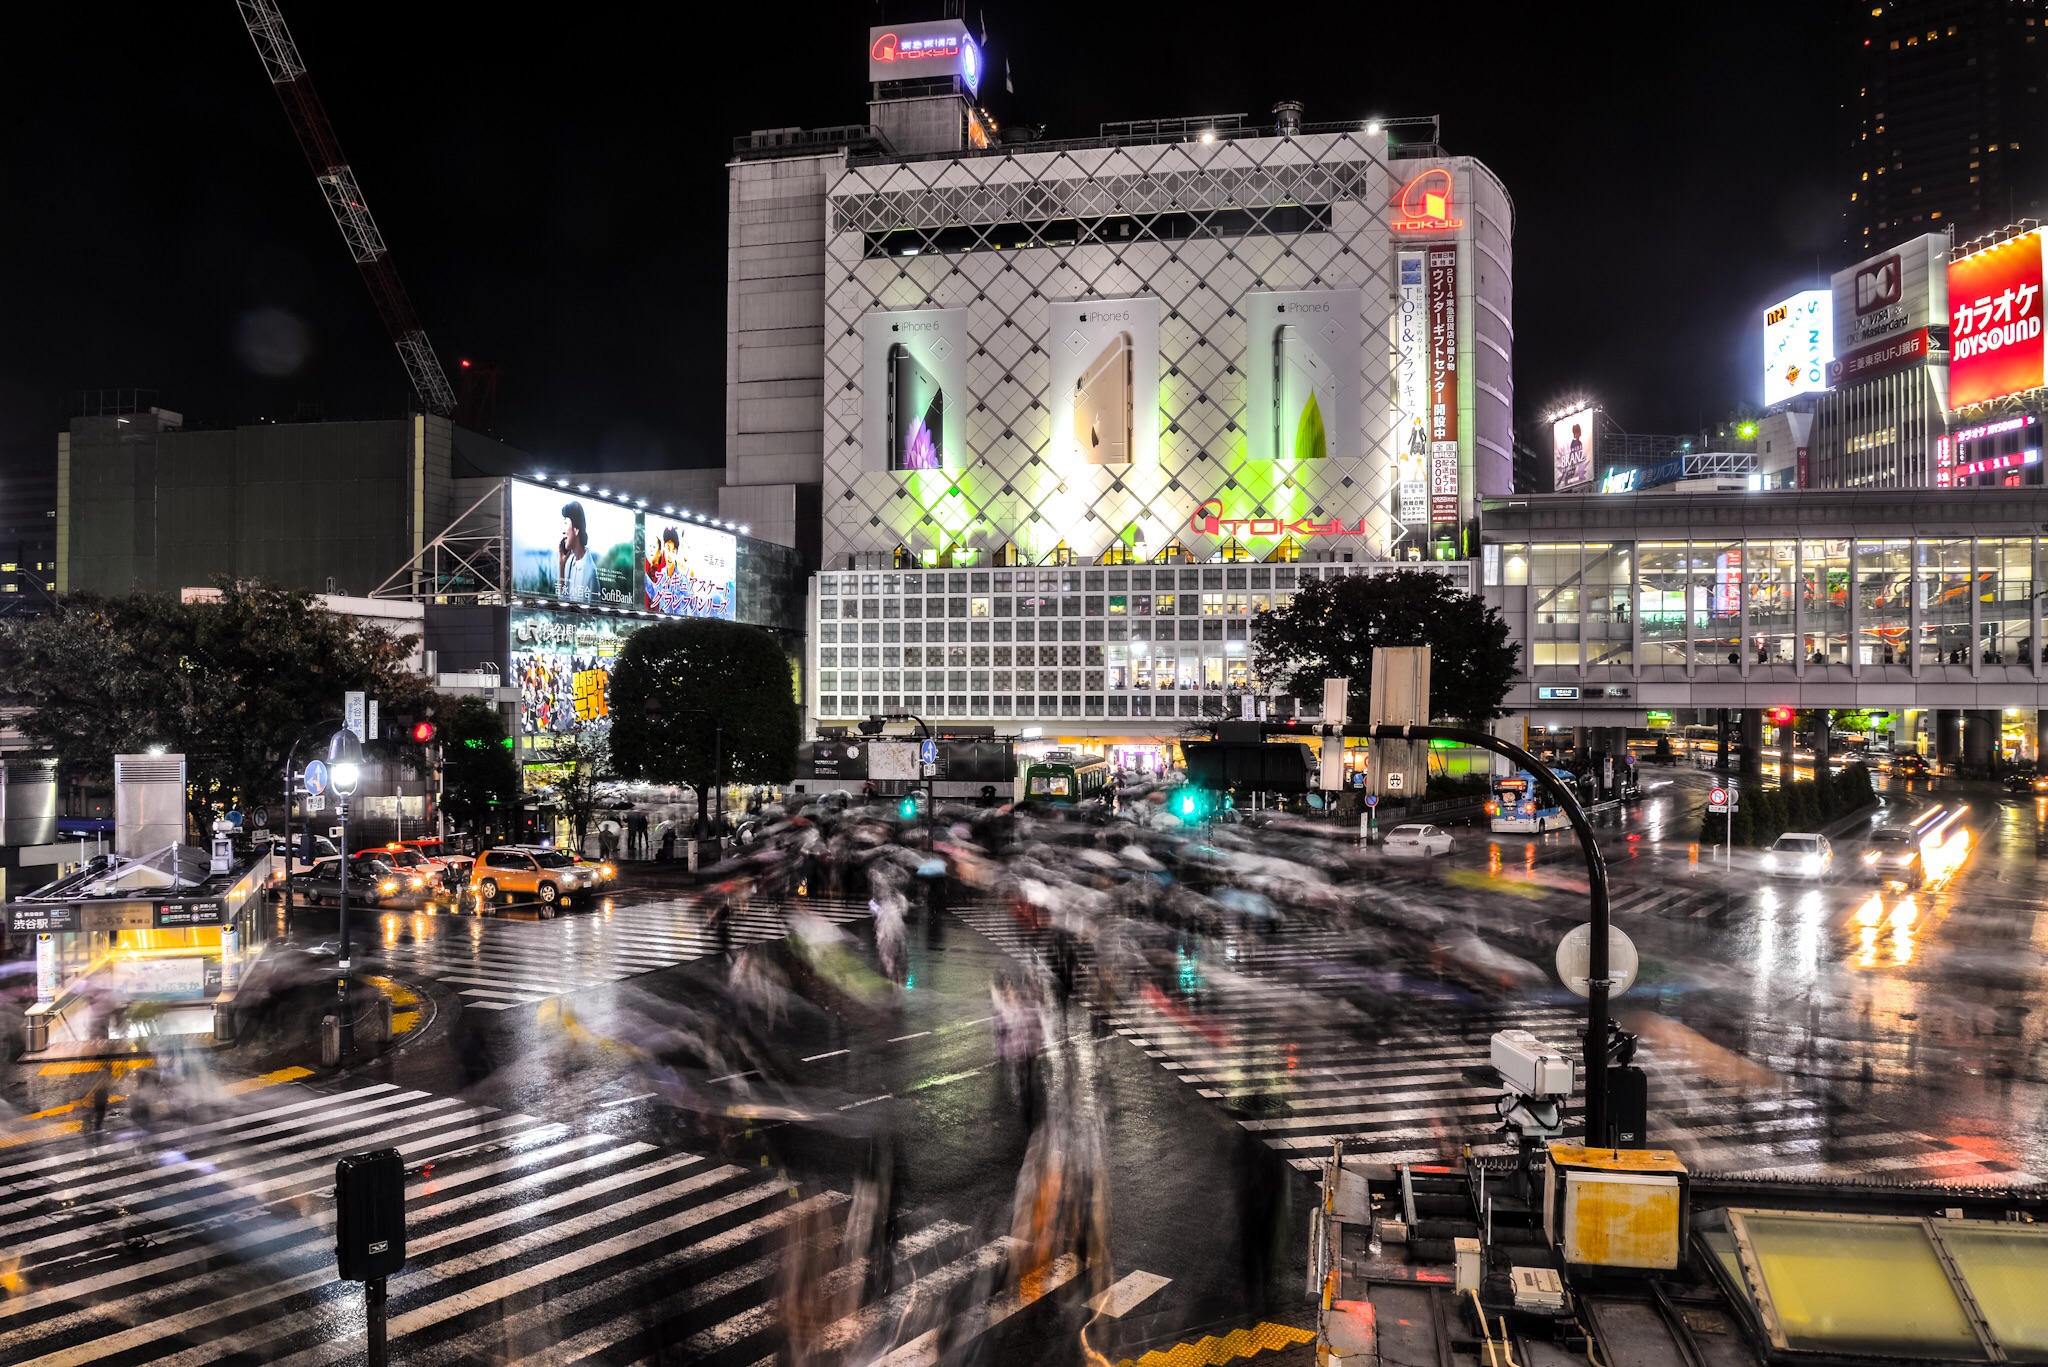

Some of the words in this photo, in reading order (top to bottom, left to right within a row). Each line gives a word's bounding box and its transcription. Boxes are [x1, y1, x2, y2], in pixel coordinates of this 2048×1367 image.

[896, 46, 959, 60] TOKYU
[1391, 219, 1463, 231] TOKYU
[1858, 262, 1897, 307] DC
[1089, 311, 1121, 322] iPhone
[1122, 310, 1130, 321] 6
[1288, 302, 1320, 313] iPhone
[1322, 302, 1330, 312] 6
[1869, 308, 1891, 325] VISA
[1953, 283, 2039, 338] カラオケ
[901, 321, 932, 332] iPhone
[933, 320, 940, 331] 6
[1861, 313, 1911, 340] MasterCard
[1953, 316, 2041, 361] JOYSOUND
[1849, 338, 1920, 372] 三菱東京UFJ銀行
[1220, 517, 1366, 536] TOKYU
[554, 582, 591, 599] 吉永小百合
[655, 572, 730, 597] フィギュアスケート
[601, 587, 633, 604] SoftBank
[650, 591, 730, 615] グランプリシリーズ
[518, 619, 541, 644] JR
[13, 918, 49, 930] 渋谷駅
